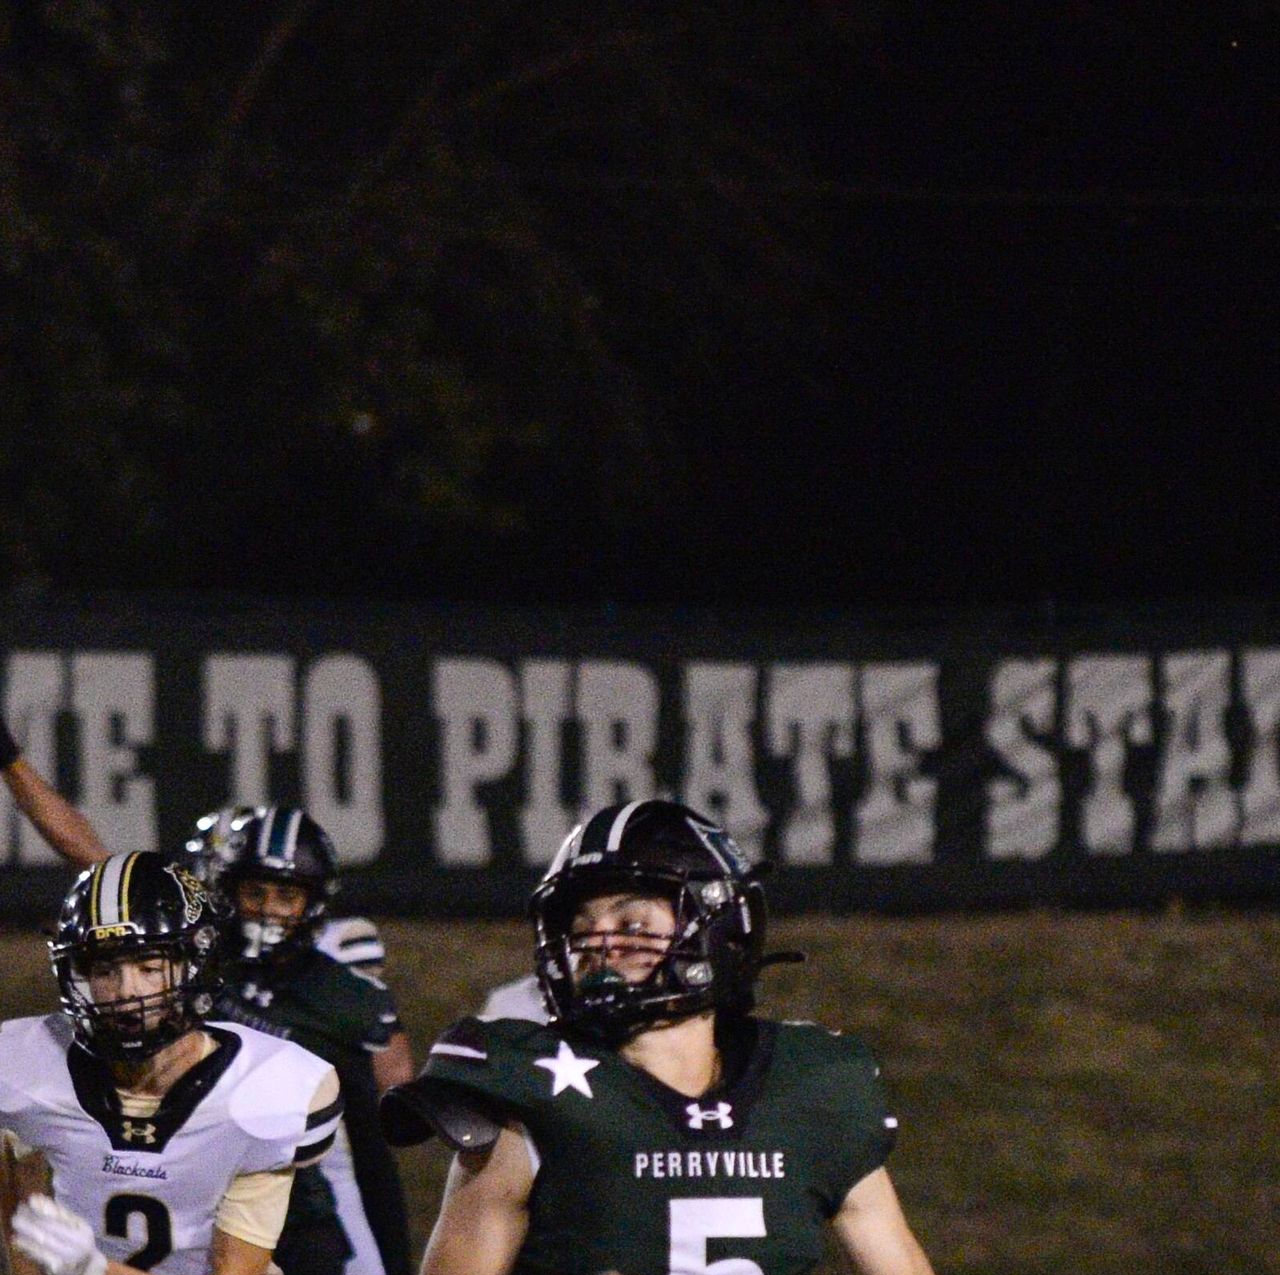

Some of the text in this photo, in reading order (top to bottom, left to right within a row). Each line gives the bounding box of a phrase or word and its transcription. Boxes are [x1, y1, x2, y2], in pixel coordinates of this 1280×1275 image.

[202, 653, 385, 868] TO
[431, 658, 939, 867] PIRATE
[101, 1155, 168, 1180] Blackcats
[635, 1151, 785, 1178] PERRYVILLE
[103, 1191, 173, 1272] 2
